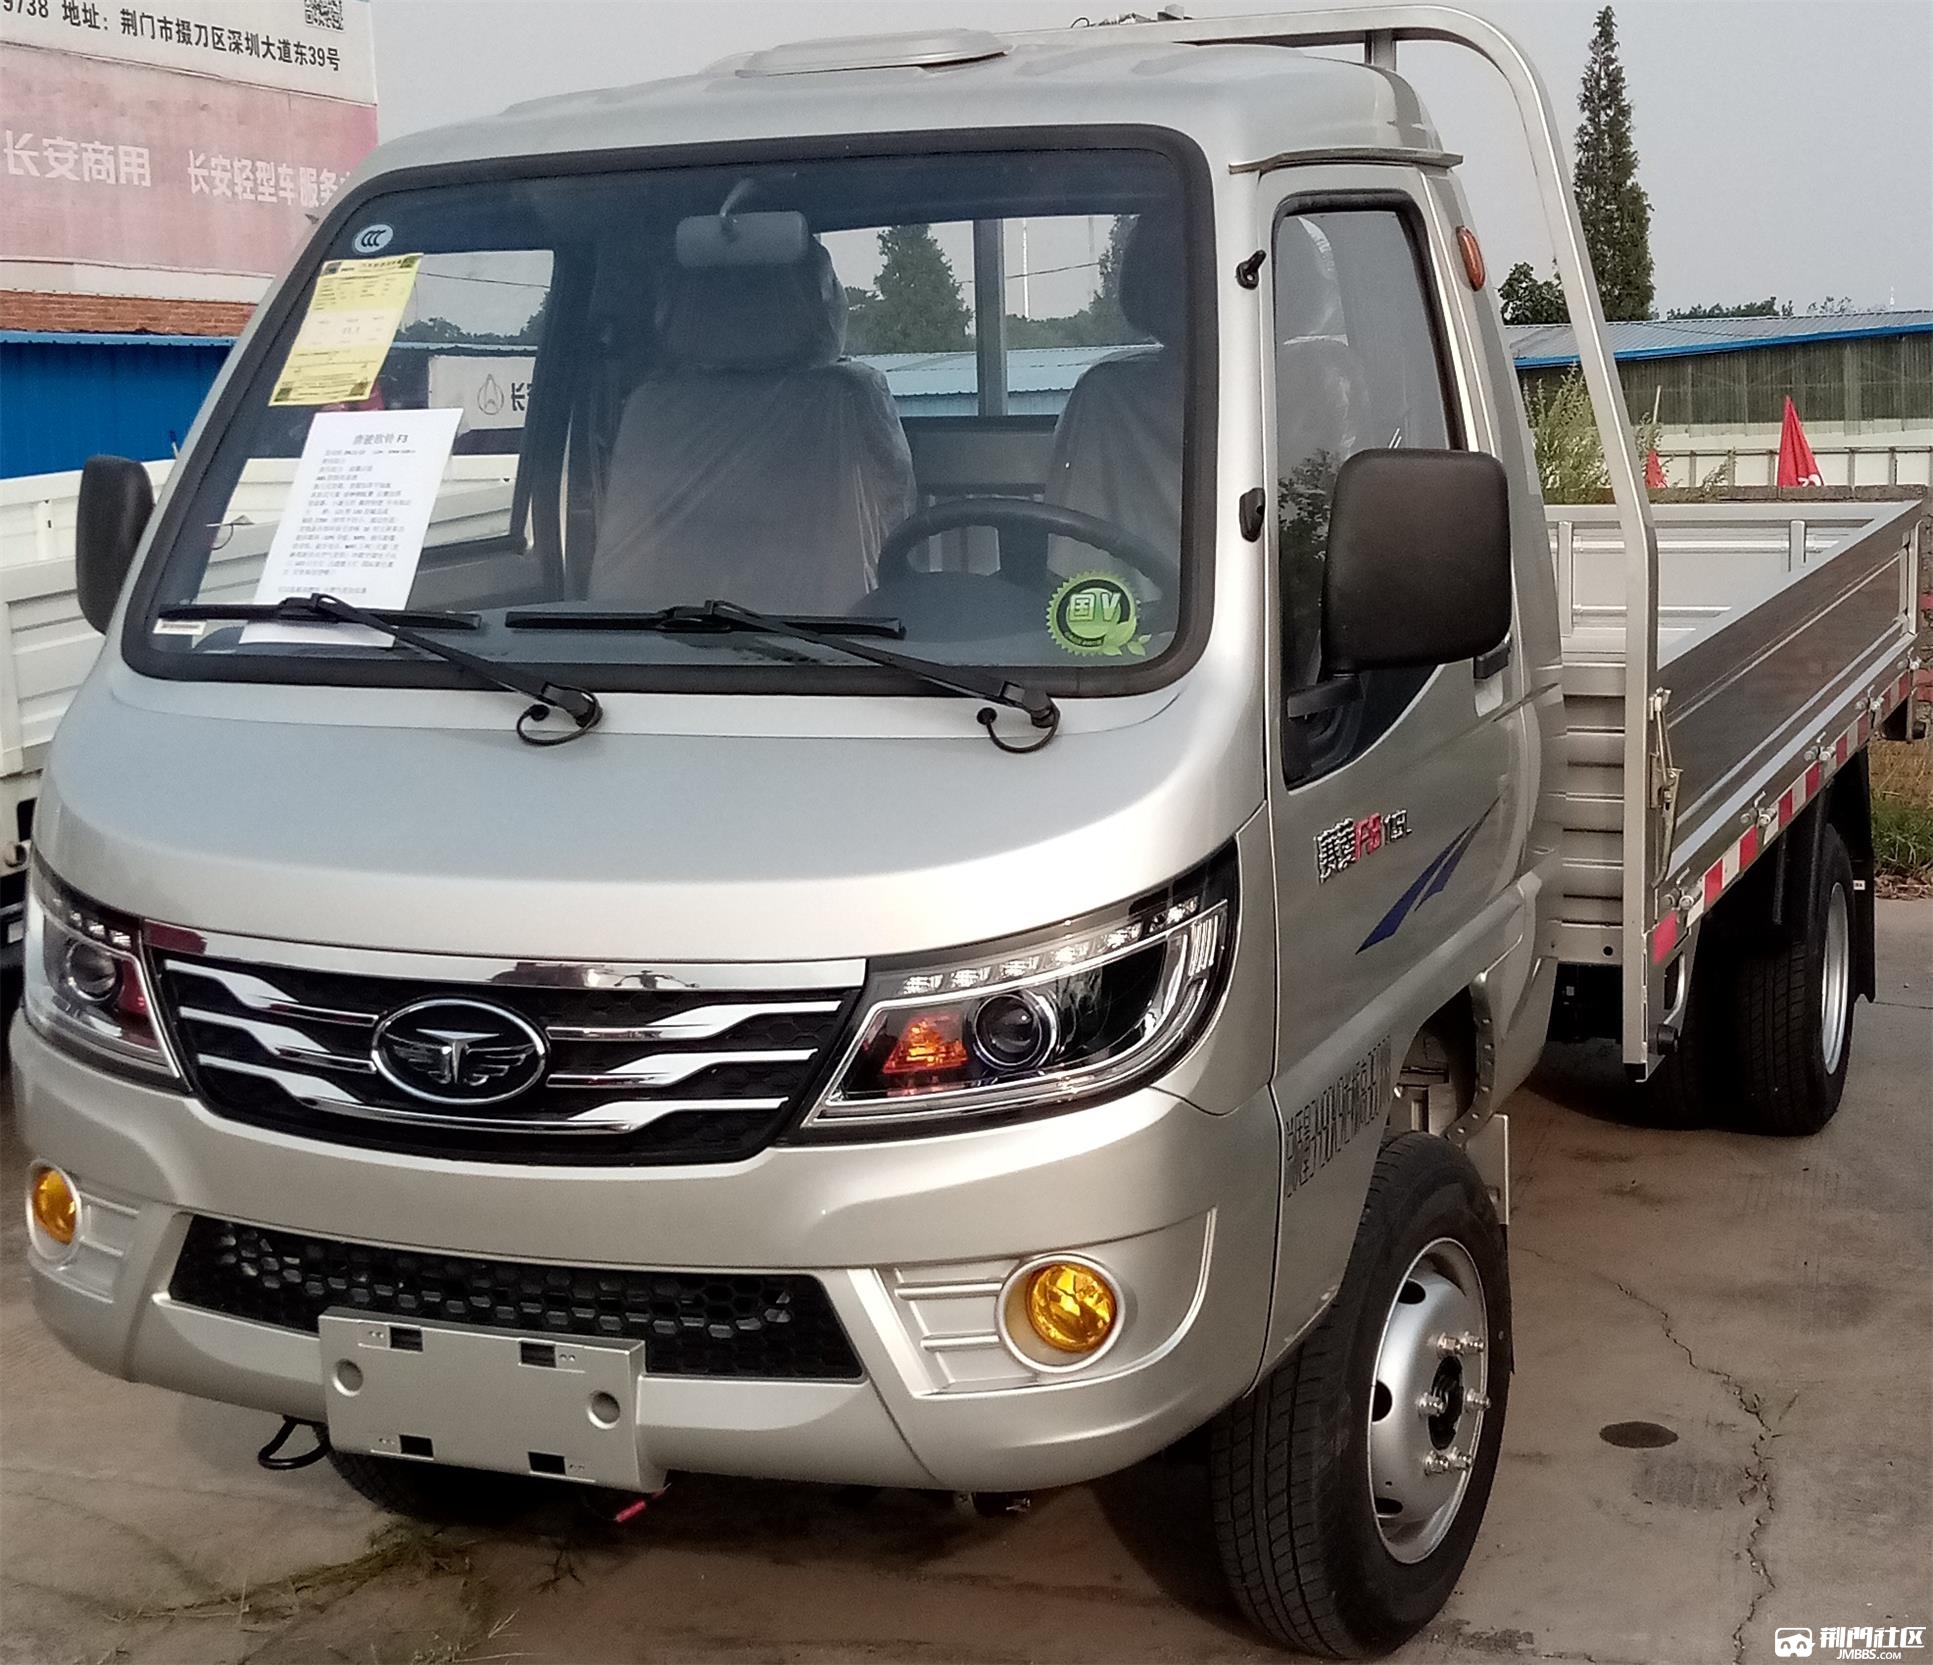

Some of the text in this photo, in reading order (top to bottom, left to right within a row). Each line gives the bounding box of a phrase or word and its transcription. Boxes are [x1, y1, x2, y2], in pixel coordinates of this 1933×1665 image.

[3, 129, 152, 187] 长安商用
[187, 149, 351, 208] 长安轻型车服务
